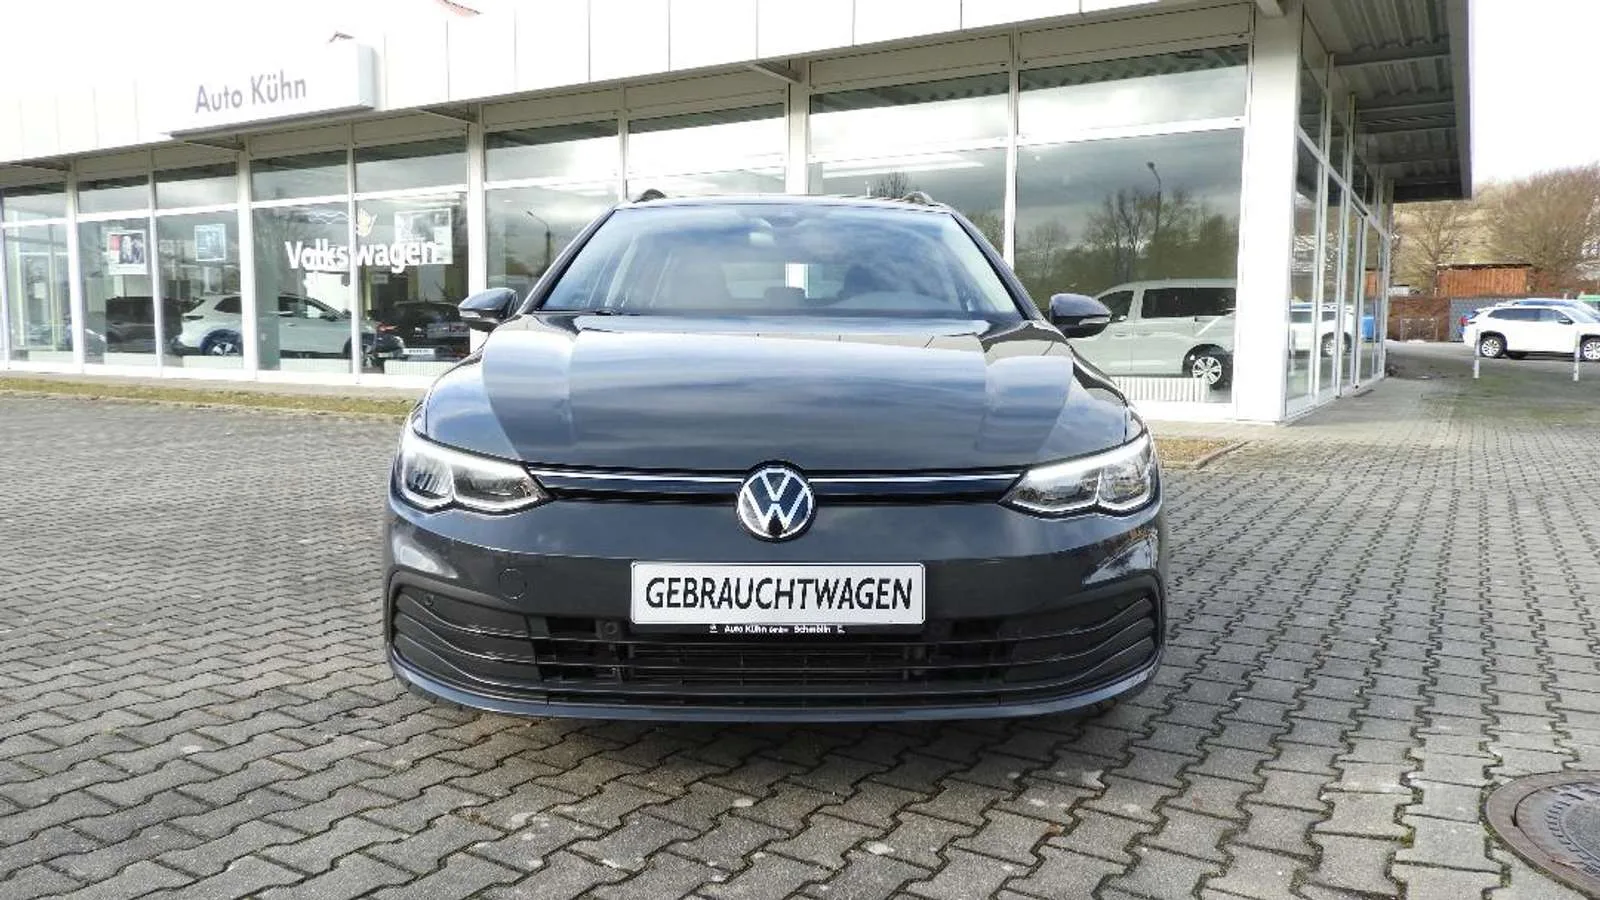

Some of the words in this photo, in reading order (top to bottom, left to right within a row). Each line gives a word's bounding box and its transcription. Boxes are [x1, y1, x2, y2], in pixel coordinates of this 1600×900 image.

[195, 84, 243, 114] Auto
[250, 69, 306, 105] Kühn
[285, 238, 437, 273] Volkswagen
[645, 577, 912, 610] GEBRAUCHTWAGEN
[724, 624, 744, 633] Auto
